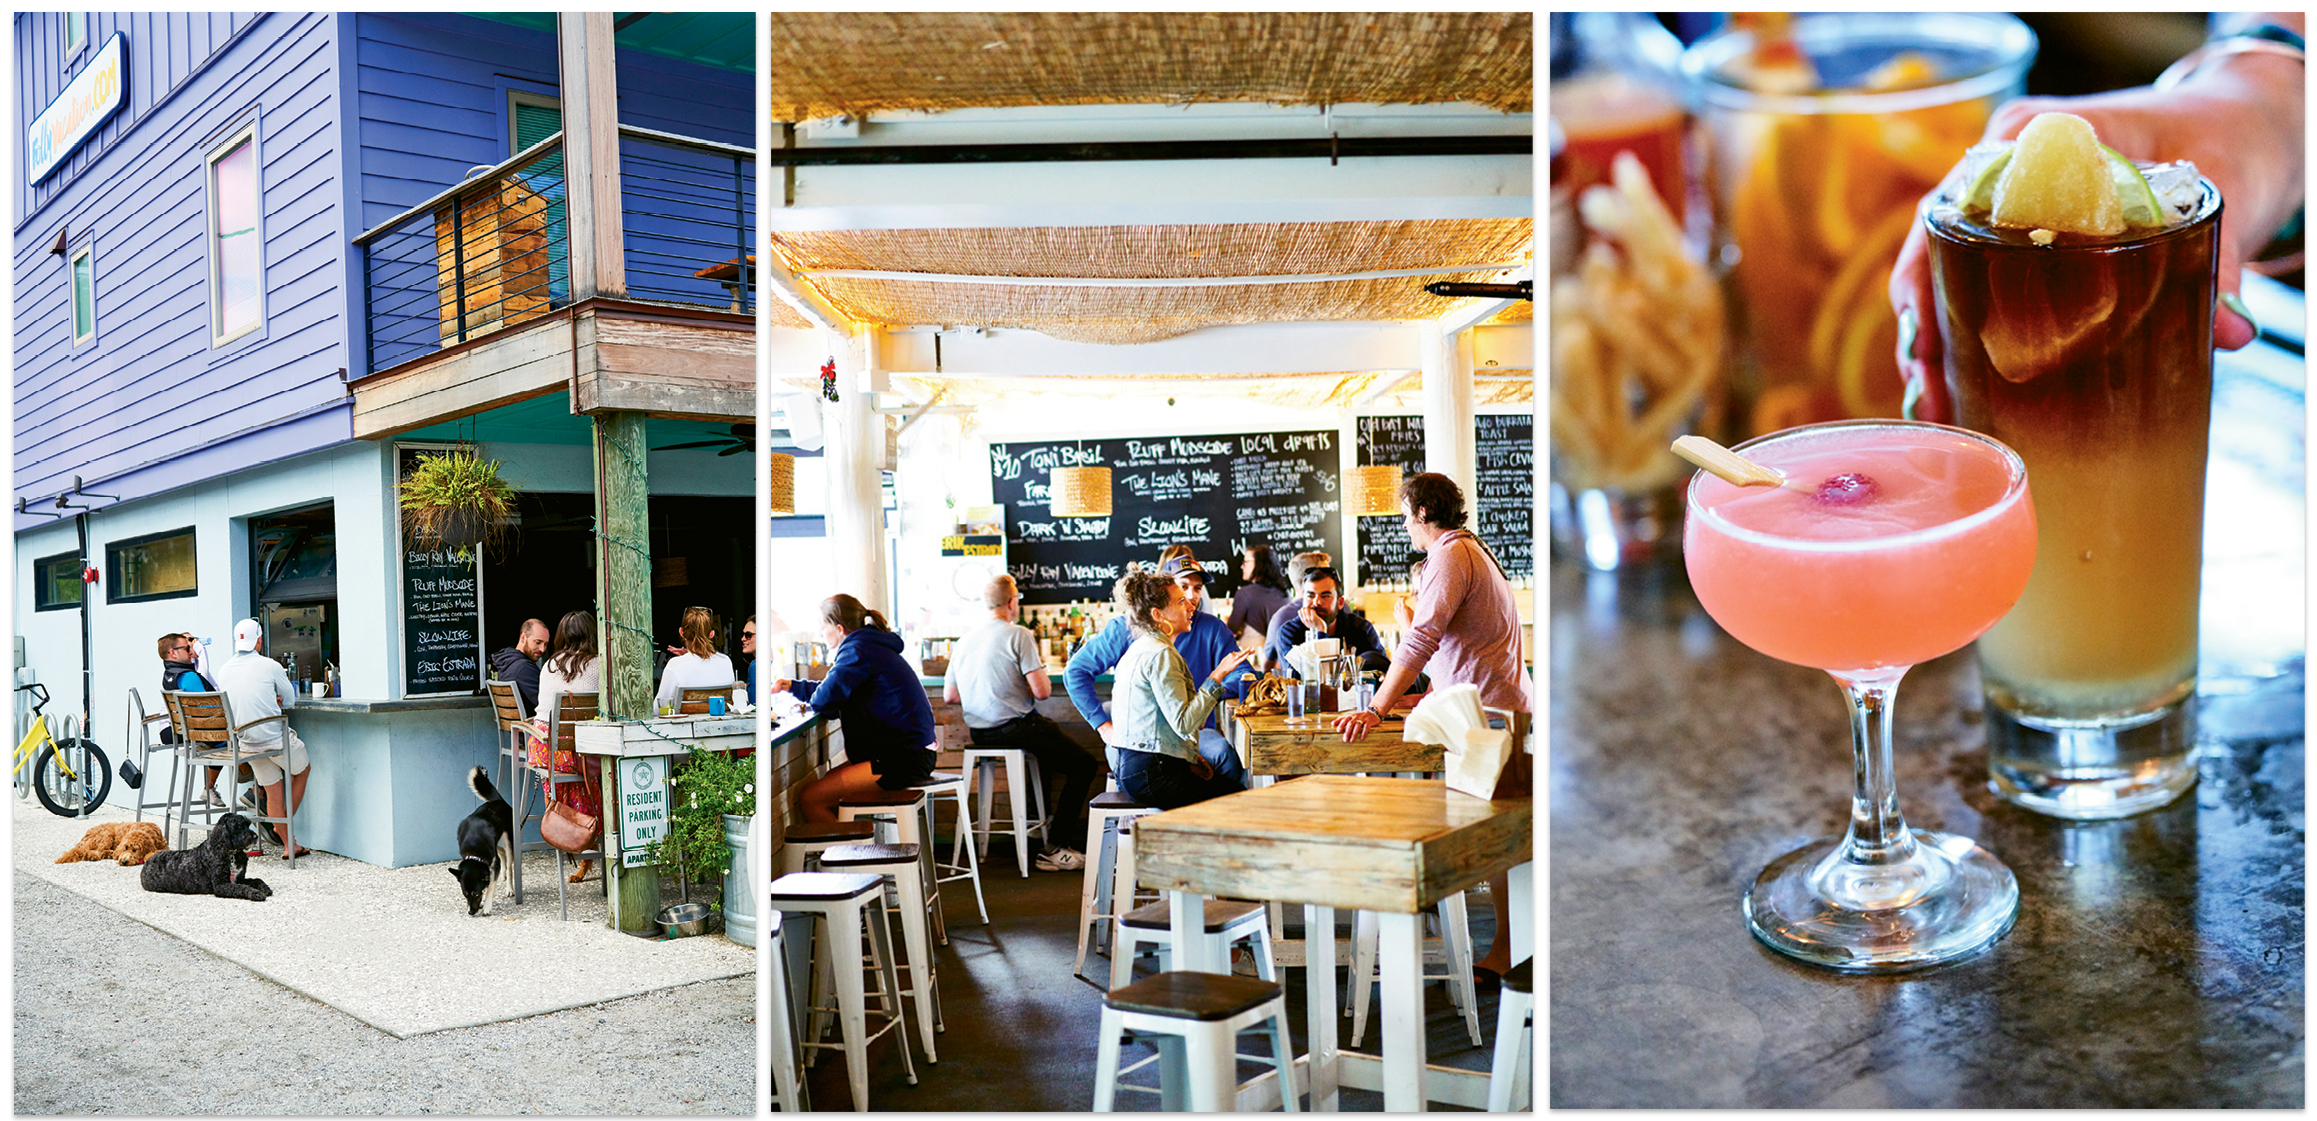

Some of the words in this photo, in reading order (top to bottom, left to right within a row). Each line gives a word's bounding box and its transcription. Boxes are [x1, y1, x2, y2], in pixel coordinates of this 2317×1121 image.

[941, 536, 966, 550] ERIK
[626, 790, 663, 807] RESIDENT
[629, 808, 662, 823] PARKING
[636, 826, 657, 840] ONLY
